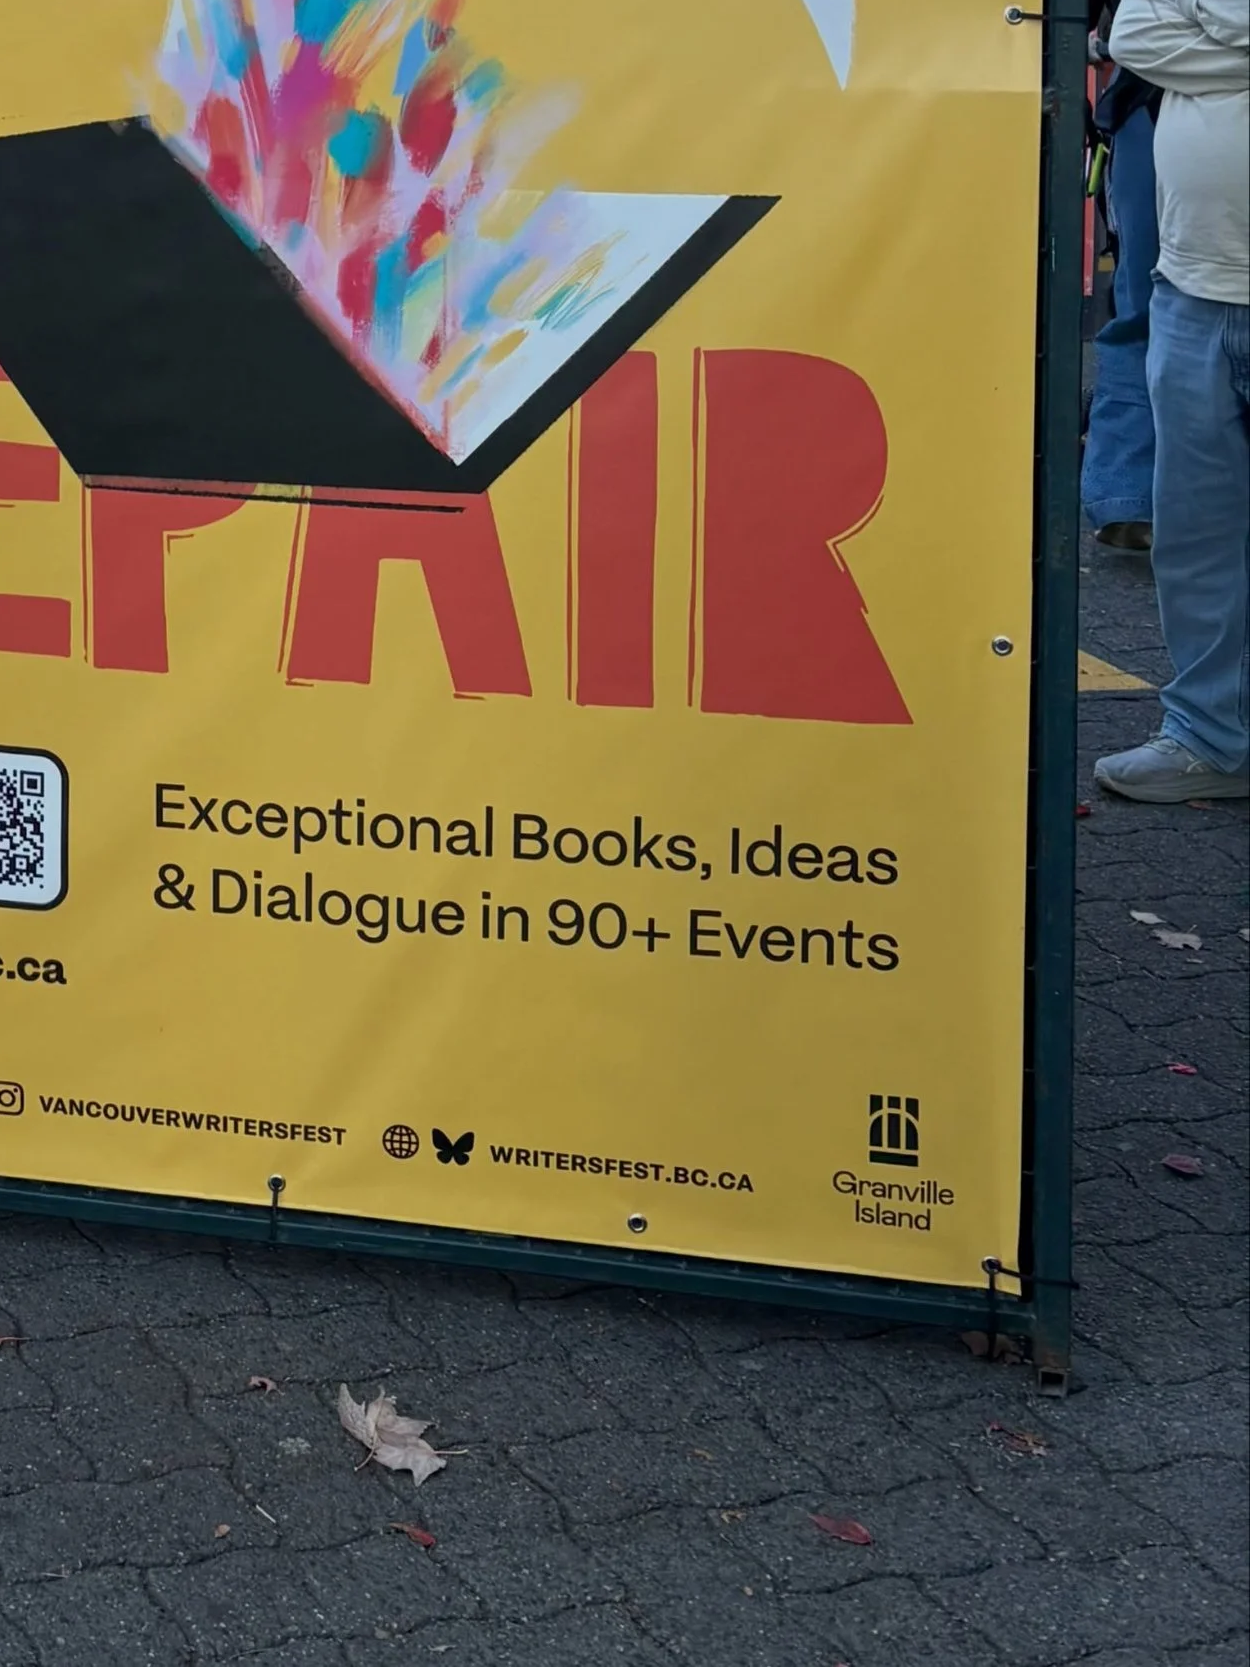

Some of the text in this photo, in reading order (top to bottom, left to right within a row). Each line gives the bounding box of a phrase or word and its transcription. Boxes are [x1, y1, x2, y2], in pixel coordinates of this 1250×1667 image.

[154, 782, 899, 885] Exceptional Books, Ideas
[153, 863, 900, 972] & Dialogue in 90+ Events
[39, 1095, 347, 1146] VANCOUVERWRITERSFEST
[489, 1143, 755, 1193] WRITERSFEST.BC.CA
[832, 1170, 955, 1206] Granville
[855, 1199, 931, 1232] Island
